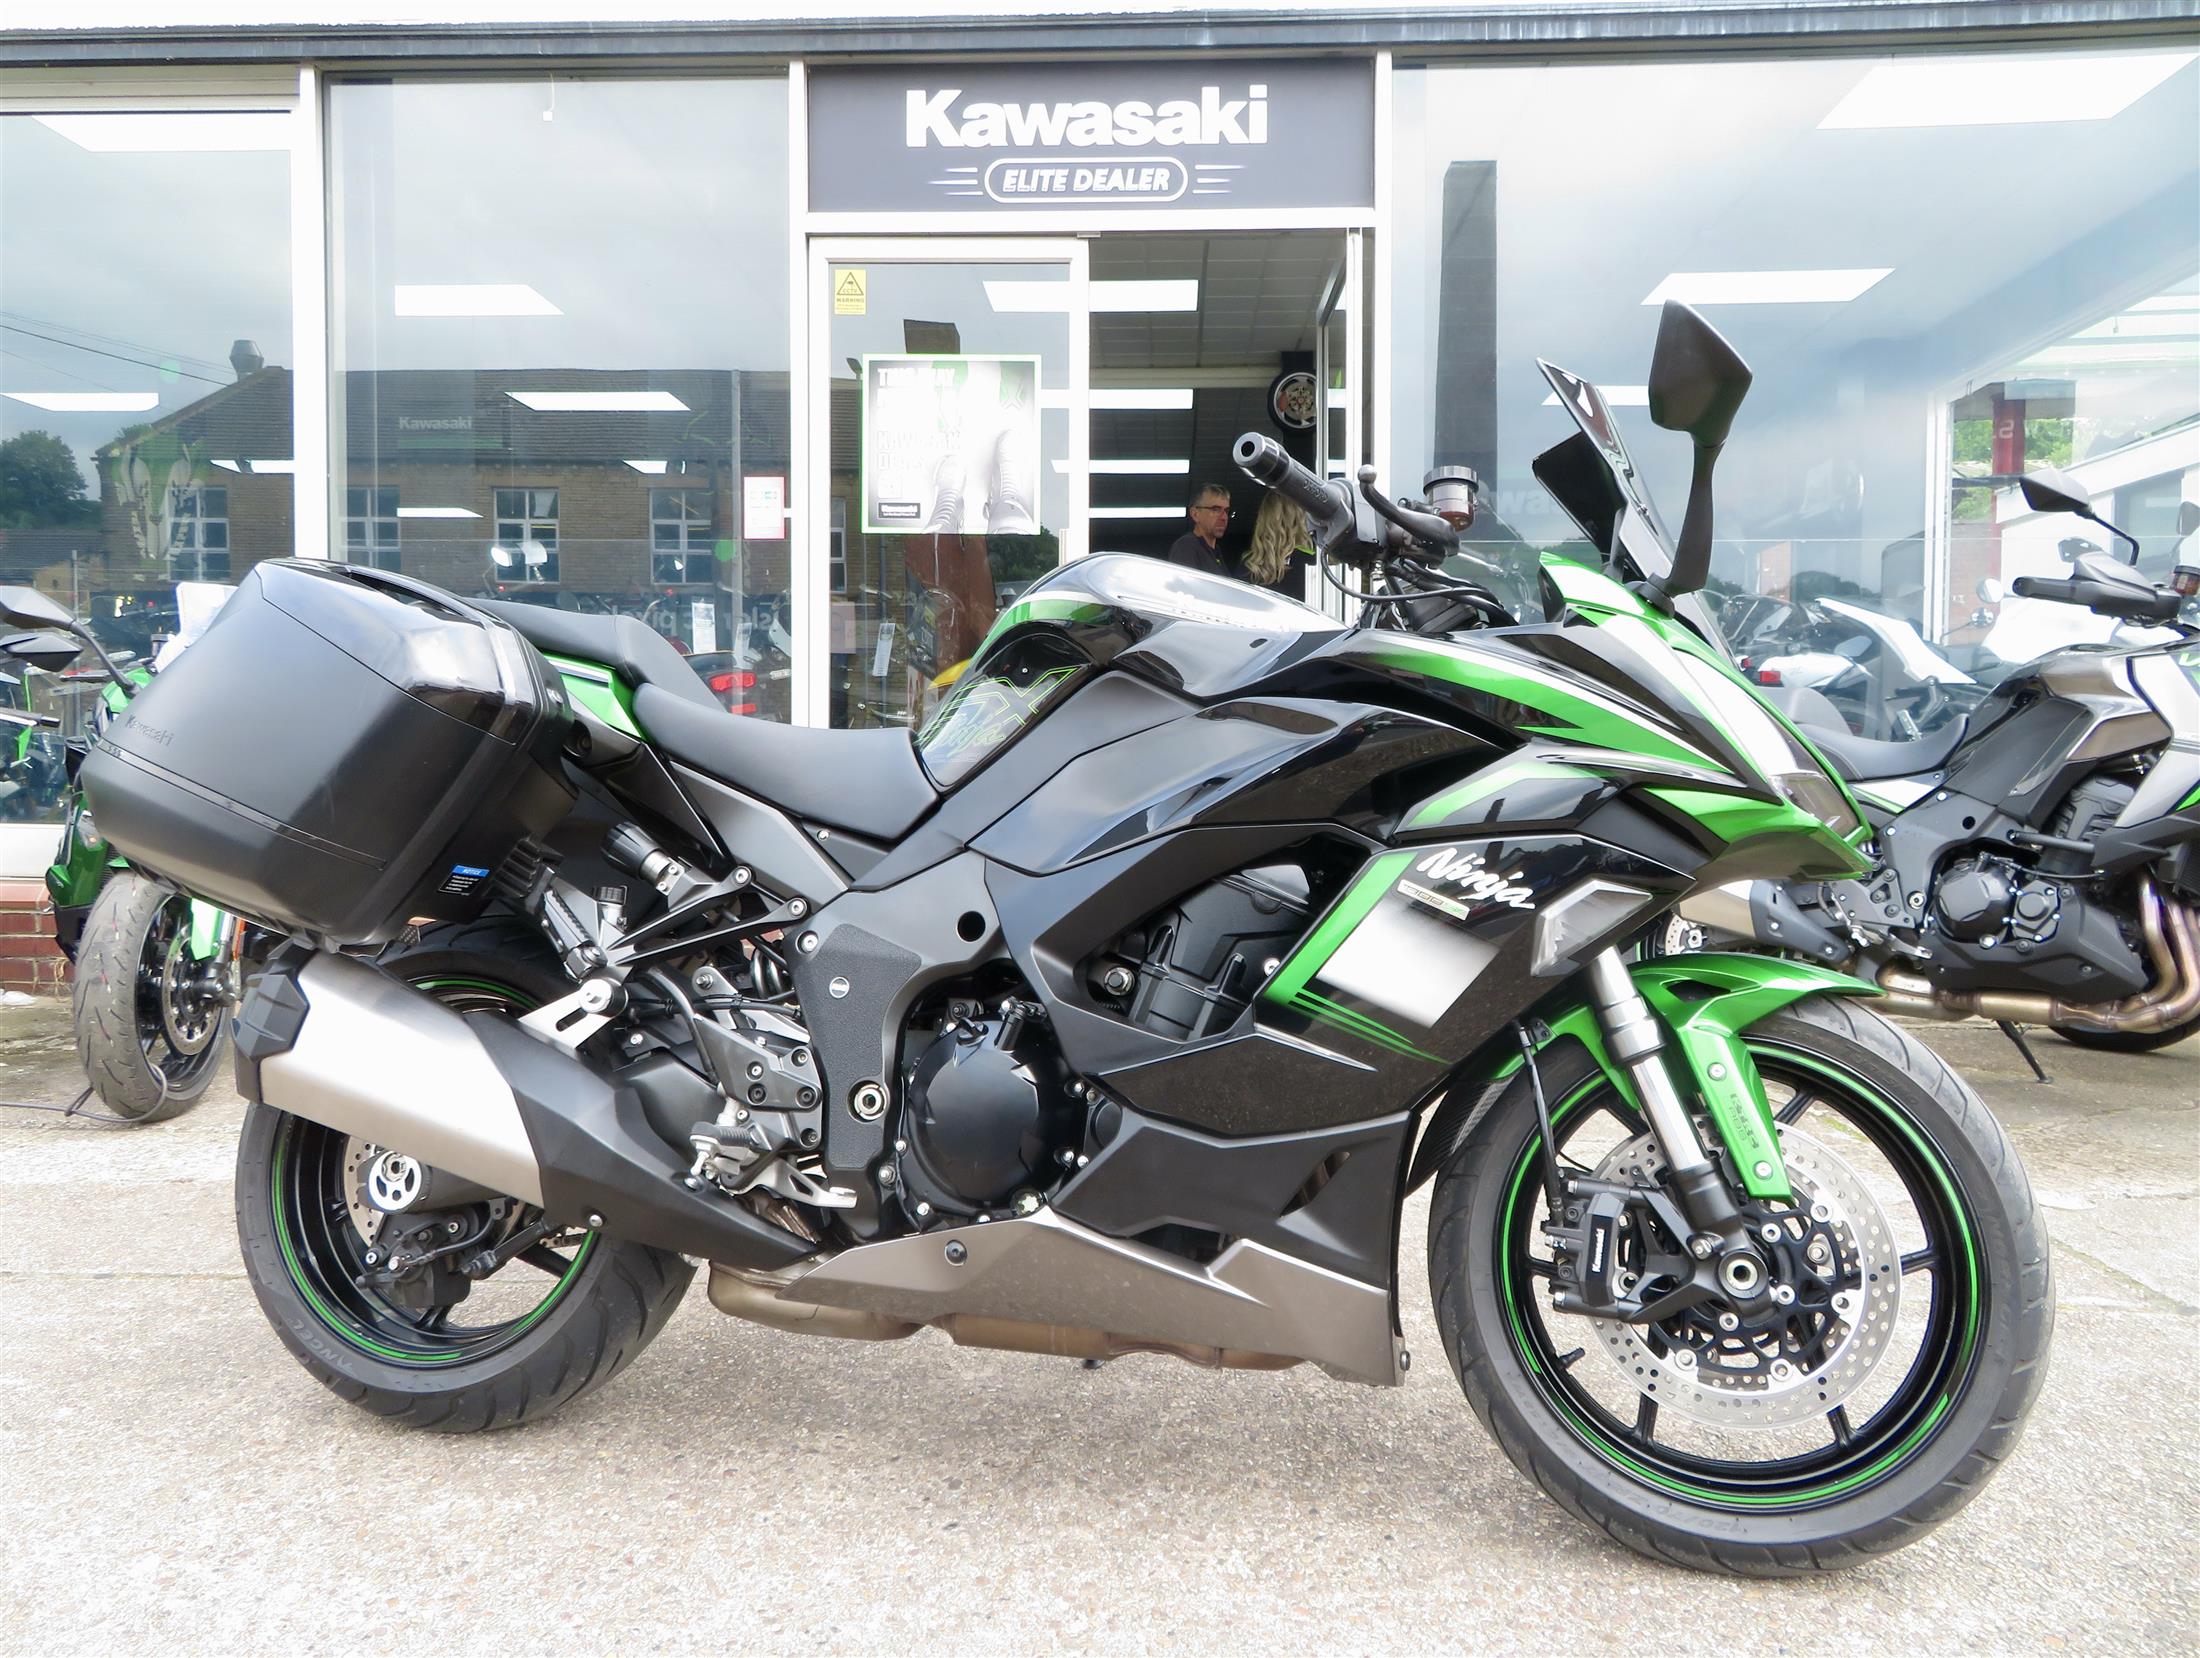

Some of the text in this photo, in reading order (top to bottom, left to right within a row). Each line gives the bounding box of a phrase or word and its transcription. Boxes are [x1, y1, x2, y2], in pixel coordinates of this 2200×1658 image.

[906, 84, 1268, 147] Kawasaki
[1002, 166, 1170, 193] ELITE DEALER
[399, 416, 472, 430] Kawasaki
[1416, 848, 1536, 910] Ninja
